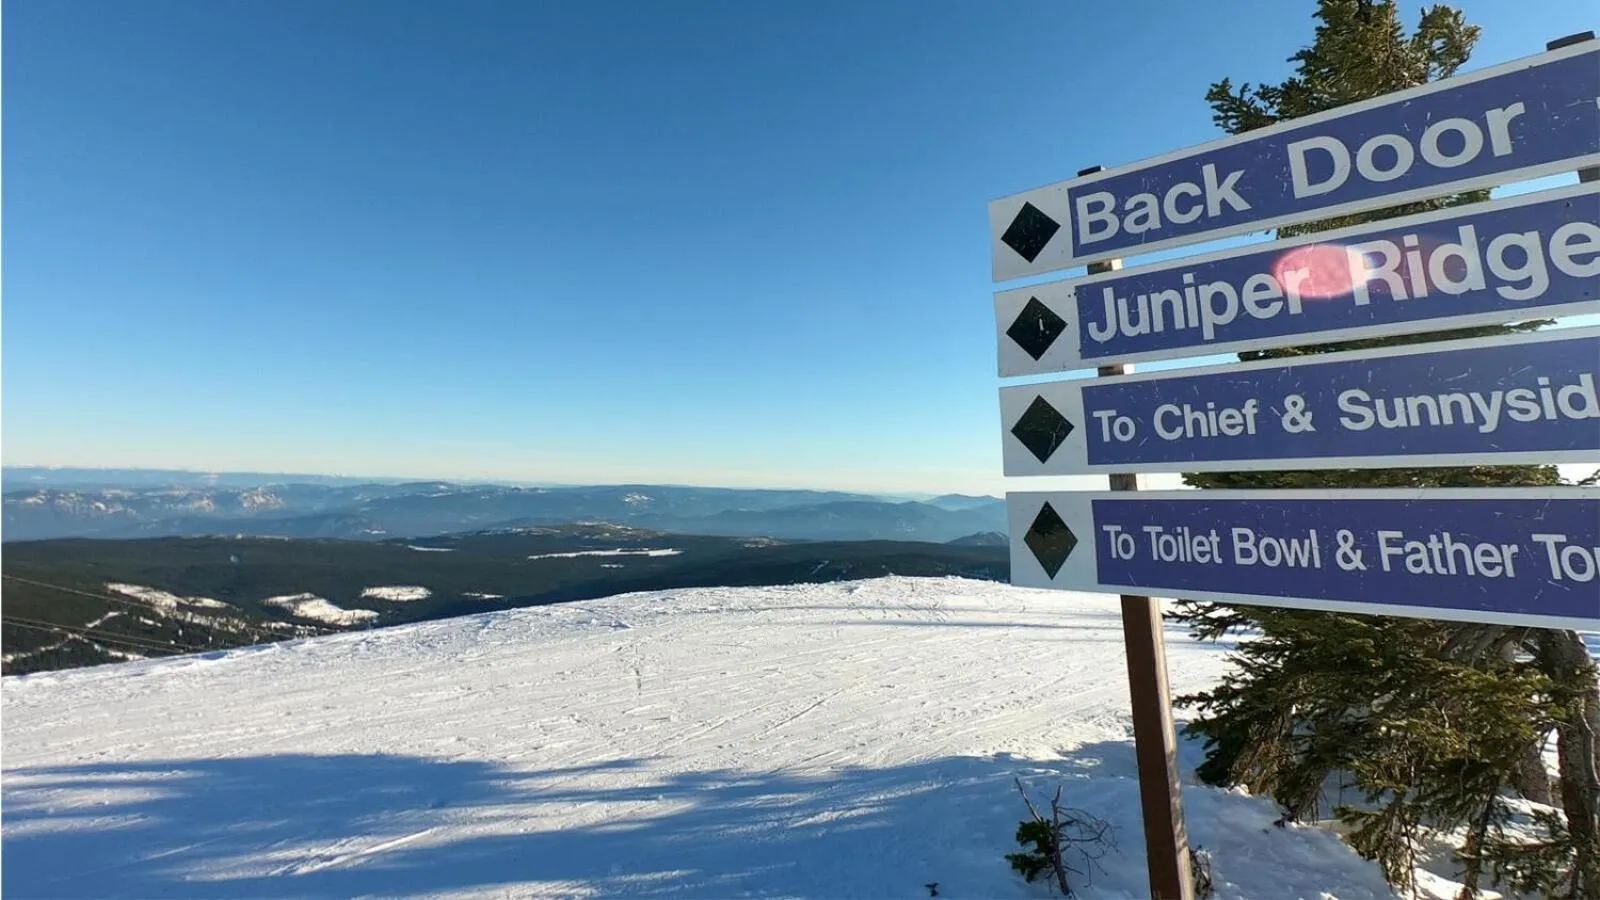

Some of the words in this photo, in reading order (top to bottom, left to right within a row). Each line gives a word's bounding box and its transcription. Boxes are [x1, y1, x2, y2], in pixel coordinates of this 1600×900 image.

[1076, 163, 1252, 246] Back
[1286, 101, 1525, 200] Door
[1087, 265, 1312, 342] Juniper
[1347, 222, 1600, 306] Ridge
[1093, 409, 1135, 442] To
[1153, 399, 1258, 440] Chief
[1281, 394, 1316, 433] &
[1102, 525, 1135, 560] To
[1143, 526, 1223, 564] Toilet
[1231, 527, 1321, 568] Bowl
[1335, 529, 1367, 571] &
[1377, 530, 1519, 578] Father
[1531, 533, 1600, 582] To
